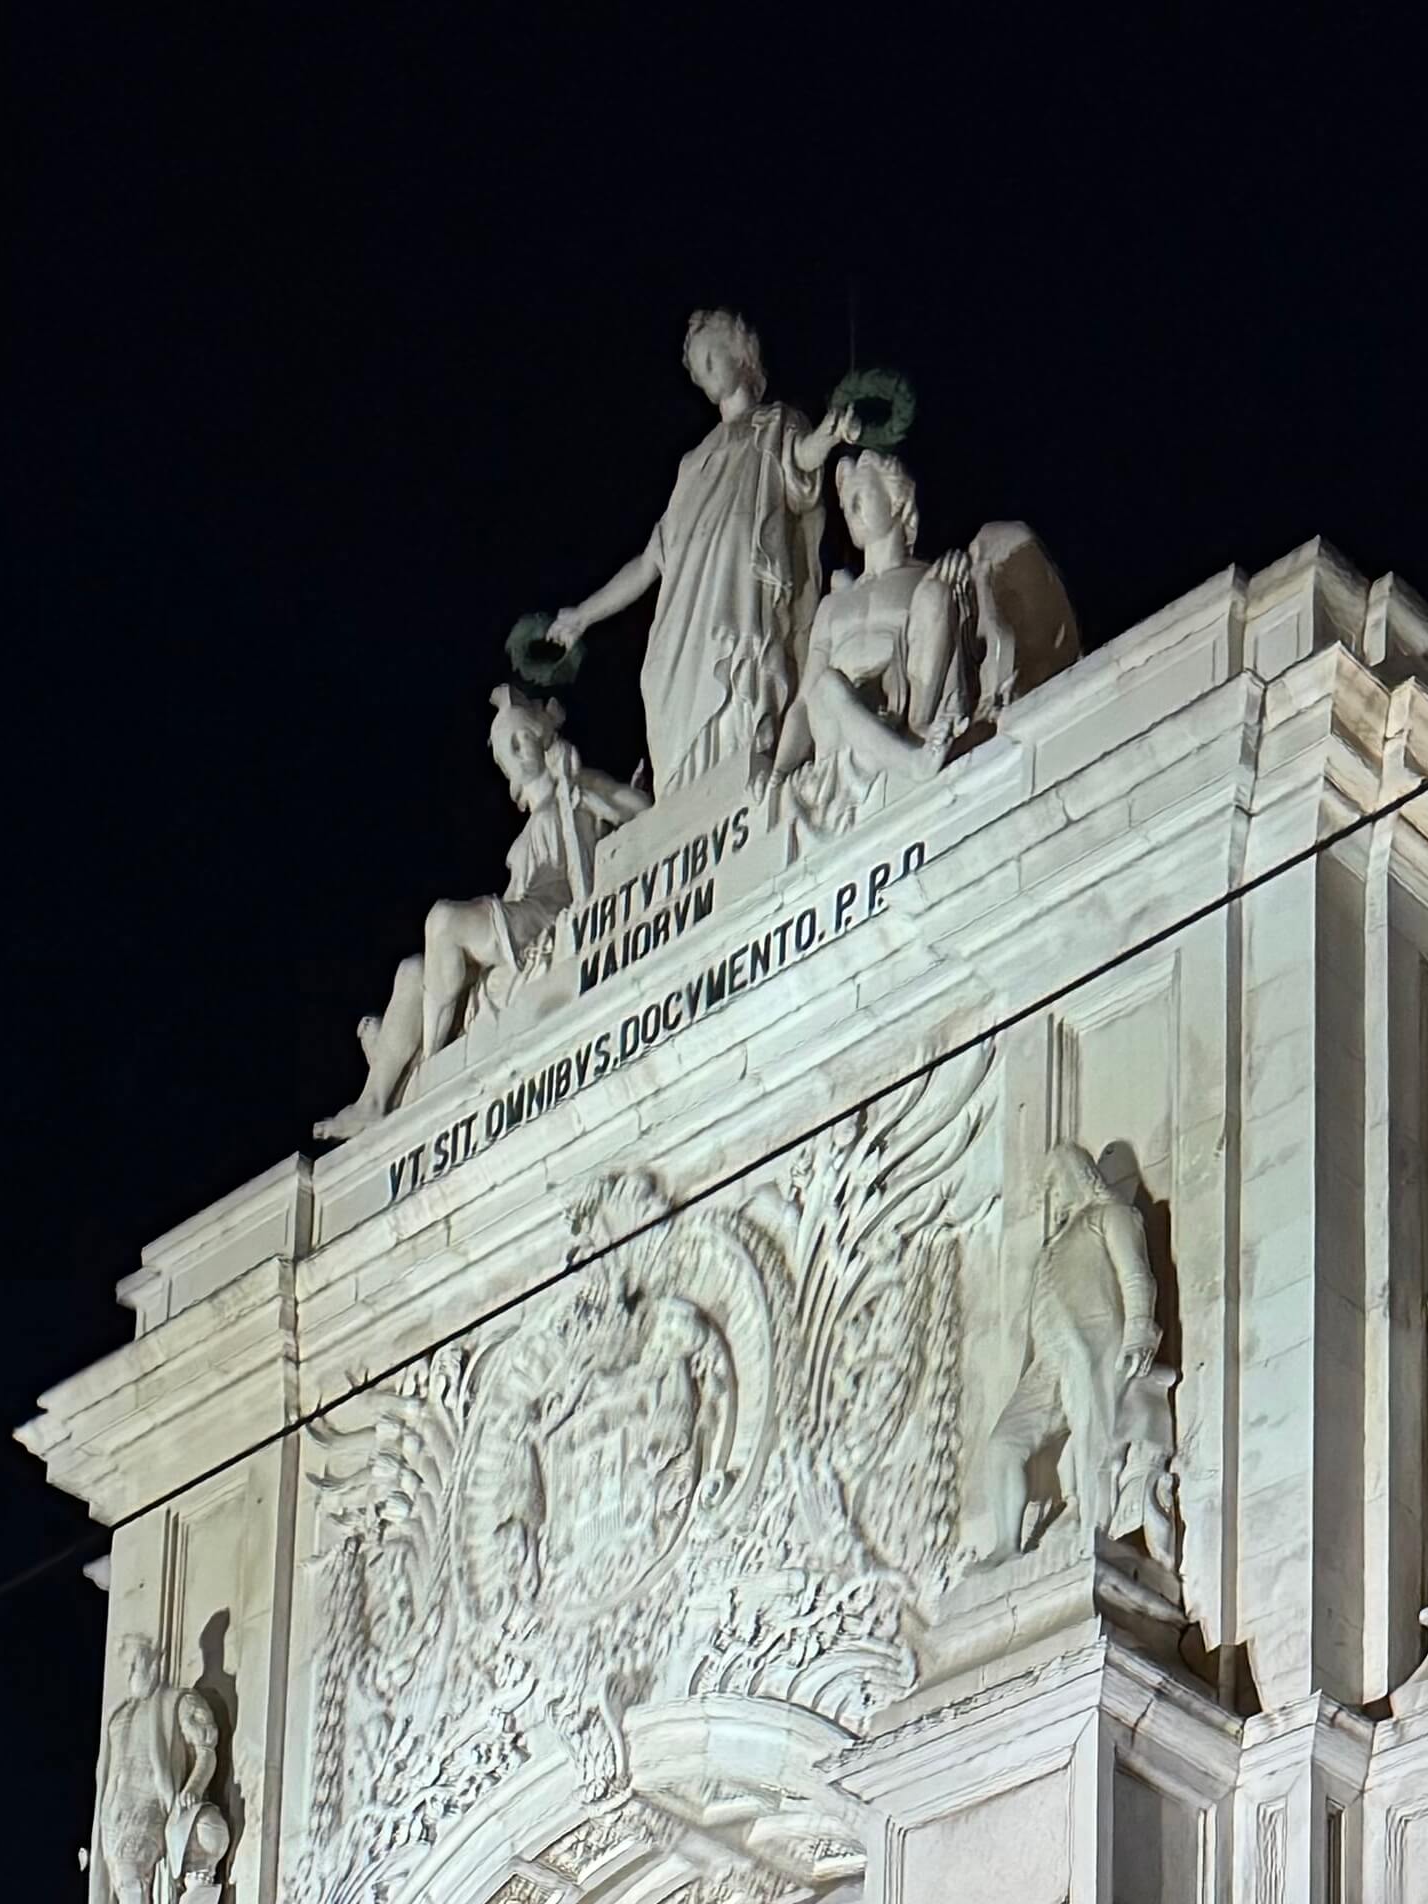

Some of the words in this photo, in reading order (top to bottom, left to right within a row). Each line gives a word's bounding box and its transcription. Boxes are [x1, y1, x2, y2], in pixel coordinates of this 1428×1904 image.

[572, 806, 750, 955] VIRTVTIBVS
[579, 877, 715, 996] MAIORVM
[432, 1111, 479, 1174] SIT.
